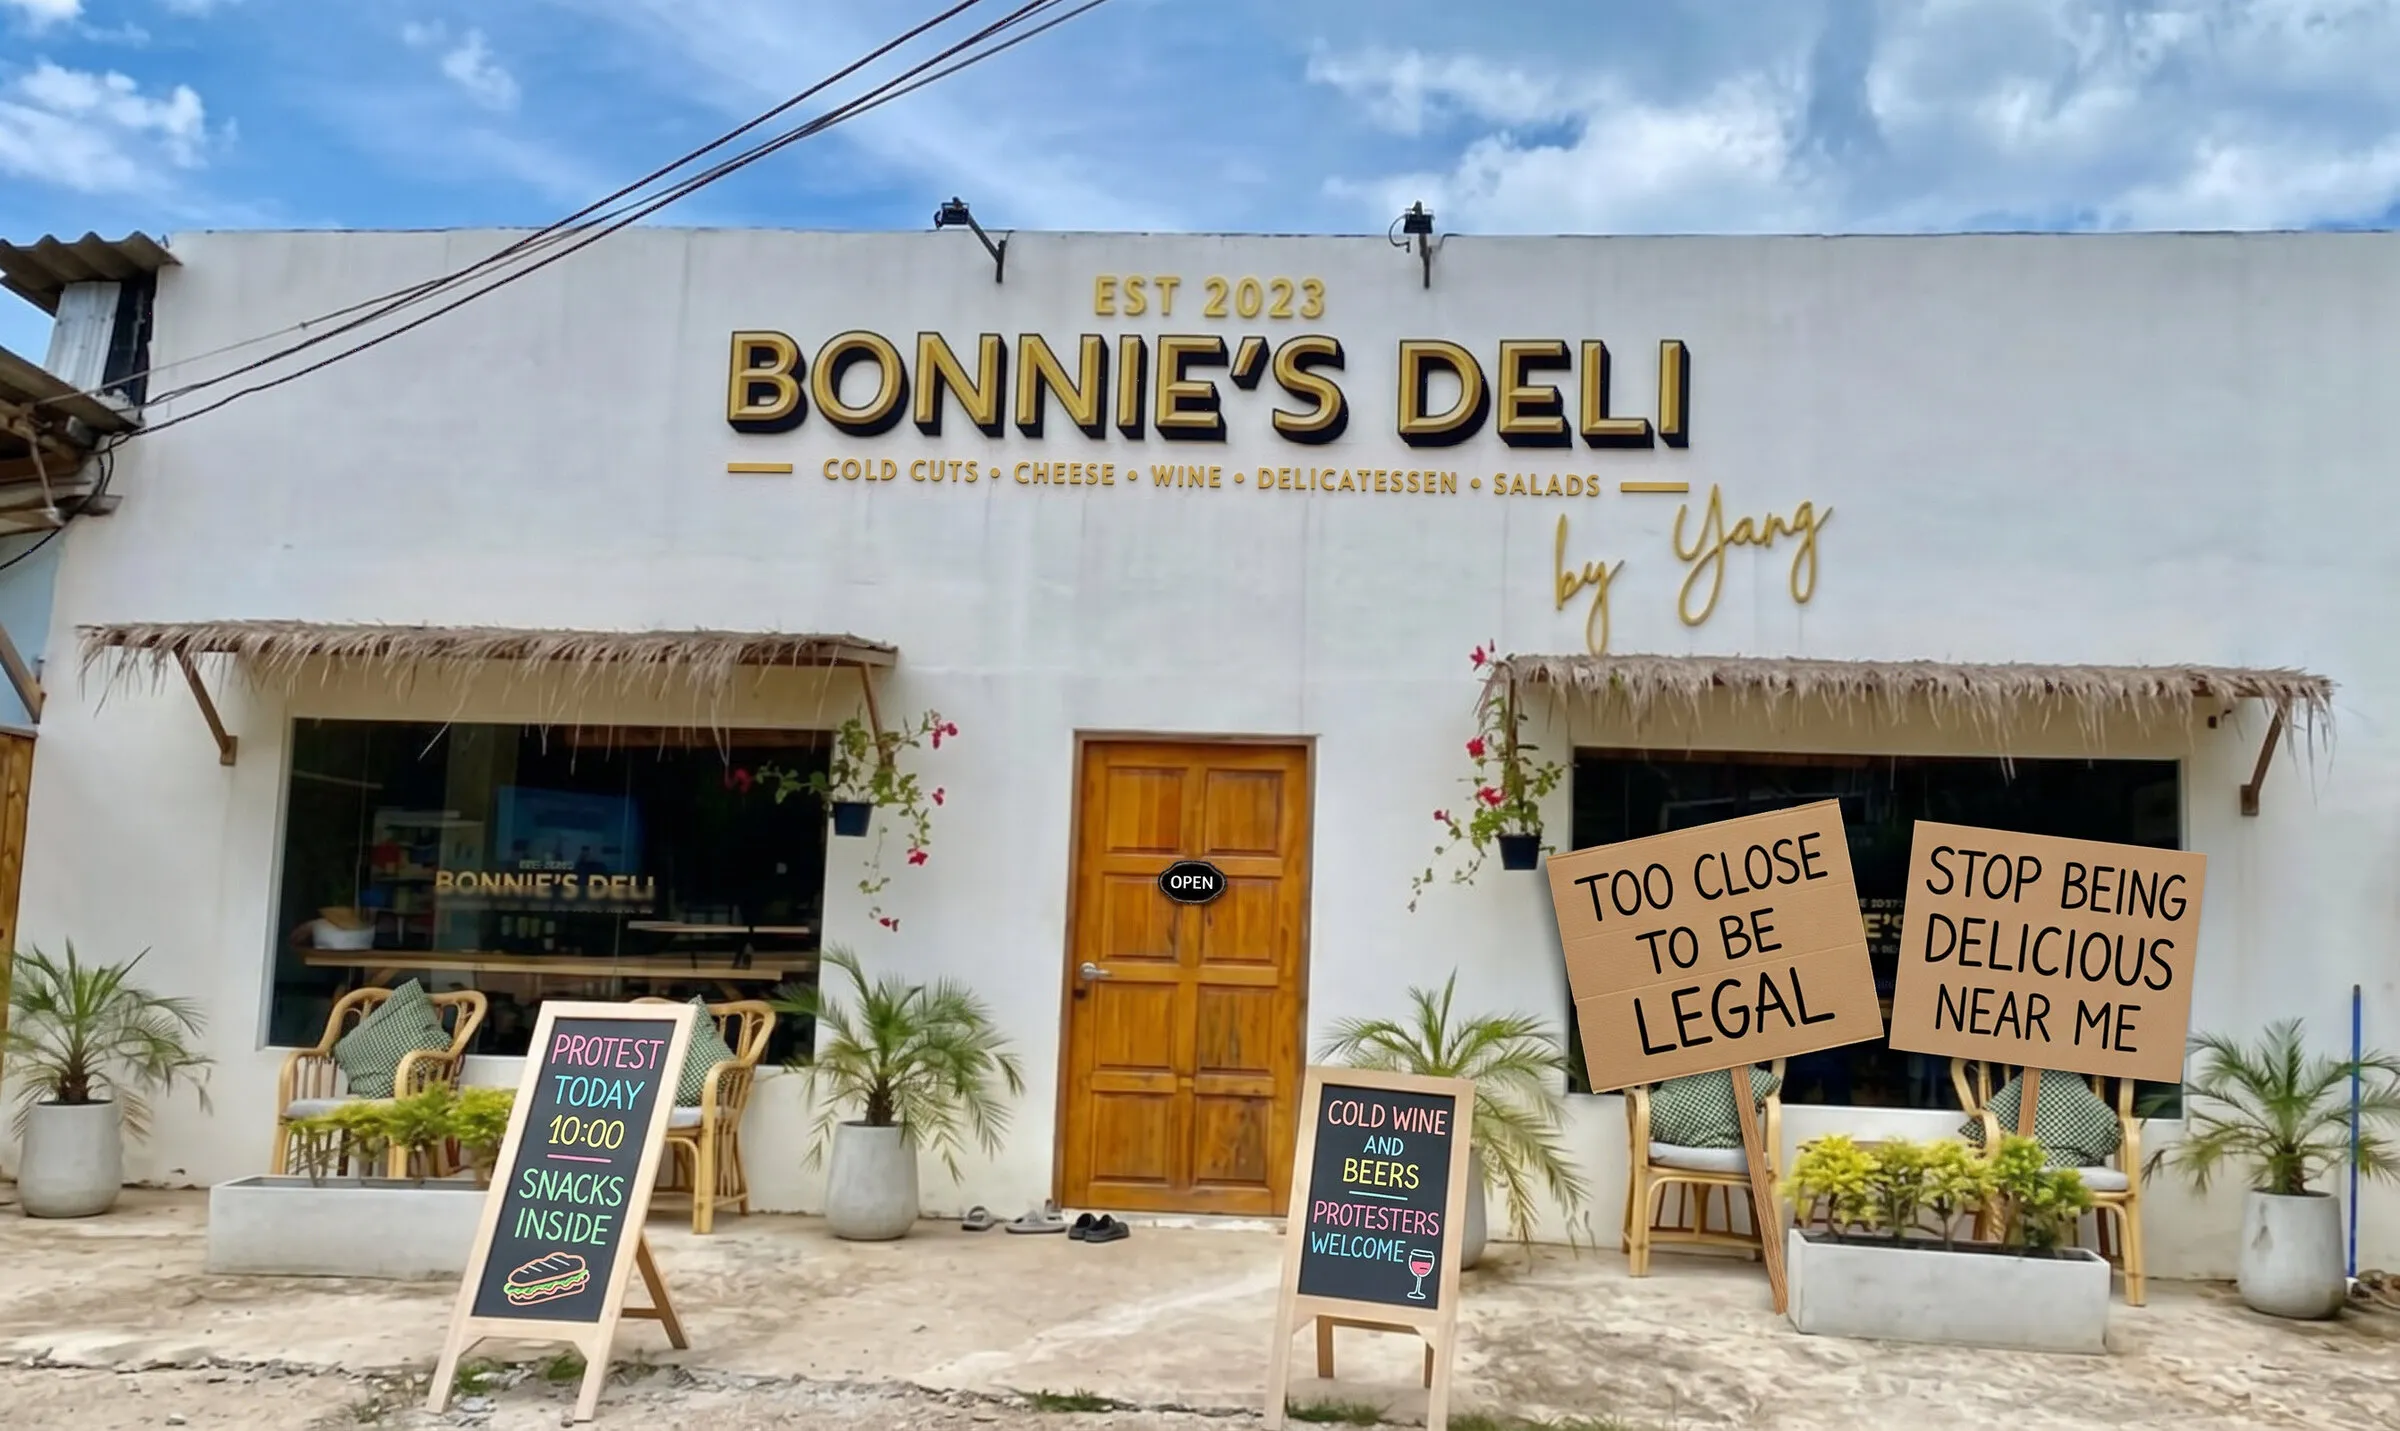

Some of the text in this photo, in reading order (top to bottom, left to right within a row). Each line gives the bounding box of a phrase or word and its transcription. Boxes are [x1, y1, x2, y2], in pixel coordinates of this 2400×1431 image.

[1094, 275, 1325, 318] EST 2023
[727, 330, 1691, 449] BONNIE'S DELI
[823, 458, 1601, 497] COLD CUTS CHEESE WINE DELICATESSEN SALADS
[1555, 483, 1833, 657] by Yang
[435, 870, 655, 901] BONNIE'S DELI
[1170, 875, 1213, 890] OPEN
[1574, 831, 1828, 922] TOO CLOSE
[1925, 845, 2187, 922] STOP BEING
[1635, 907, 1783, 975] TO BE
[1925, 912, 2174, 991] DELICIOUS
[1633, 965, 1835, 1056] LEGAL
[1935, 983, 2142, 1053] NEAR ME
[551, 1033, 664, 1070] PROTEST
[554, 1075, 645, 1110] TODAY
[548, 1114, 625, 1150] 10:00
[1328, 1100, 1448, 1136] COLD WINE
[1363, 1135, 1404, 1156] AND
[518, 1168, 625, 1207] SNACKS
[1342, 1158, 1419, 1190] BEERS
[514, 1207, 612, 1245] INSIDE
[1312, 1200, 1440, 1236] PROTESTERS
[1311, 1231, 1406, 1263] WELCOME
